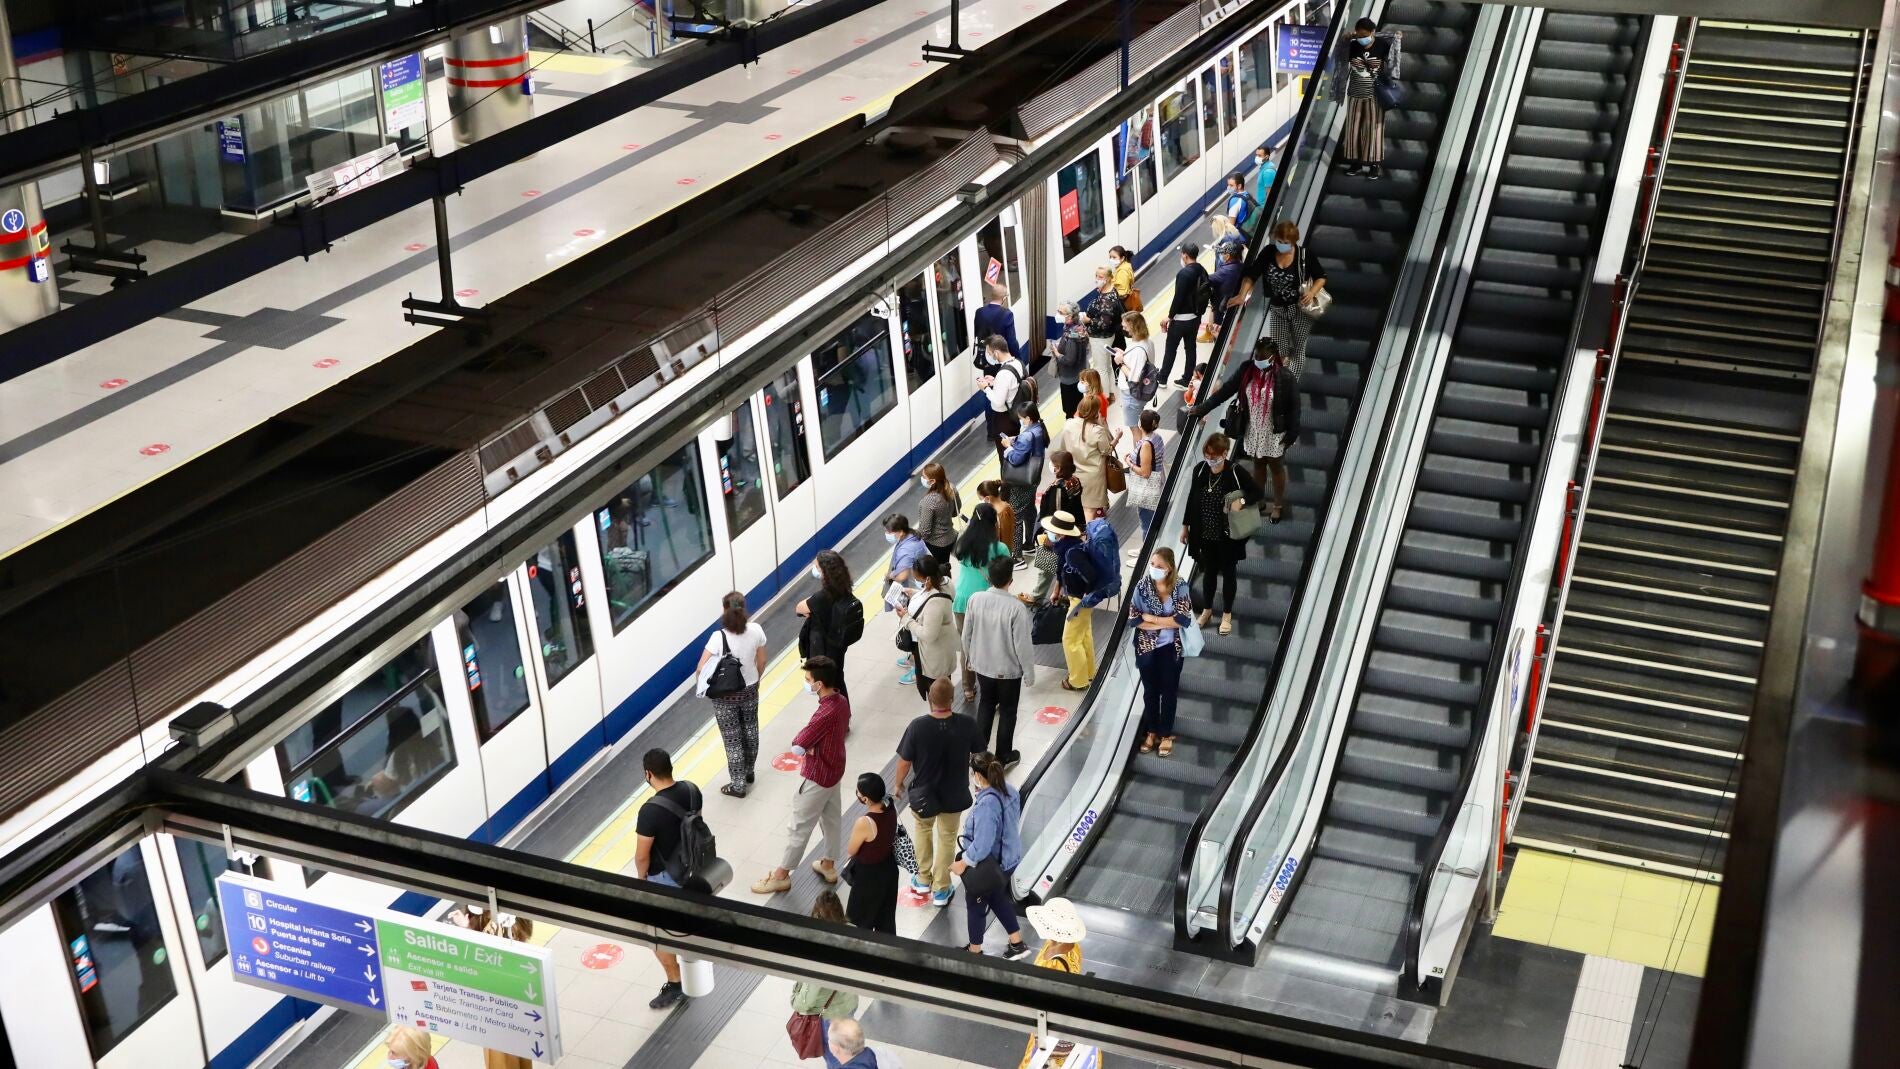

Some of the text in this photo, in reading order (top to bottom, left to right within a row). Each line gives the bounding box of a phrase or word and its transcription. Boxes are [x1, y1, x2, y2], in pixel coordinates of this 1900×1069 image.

[266, 899, 298, 913] Circular
[248, 915, 266, 931] 10
[269, 918, 301, 932] Hospital
[303, 926, 330, 938] Infanta
[271, 928, 326, 948] Puerta del Sur
[404, 929, 459, 956] Salida
[474, 946, 503, 967] Exit
[255, 958, 292, 973] Ascensor
[293, 968, 299, 976] a
[304, 971, 318, 980] Lift
[318, 974, 326, 982] to
[274, 951, 336, 974] Suburban railway
[406, 952, 444, 967] Ascensor
[454, 963, 478, 976] salida
[432, 981, 458, 994] Tarjeta
[459, 988, 488, 1002] Transp.
[433, 992, 514, 1019] Public Transport Card
[415, 1010, 452, 1025] Ascensor
[465, 1023, 478, 1032] Lift
[479, 1026, 487, 1034] to
[435, 1004, 478, 1021] Bibliometro
[484, 1016, 506, 1029] Metro
[508, 1022, 532, 1036] library
